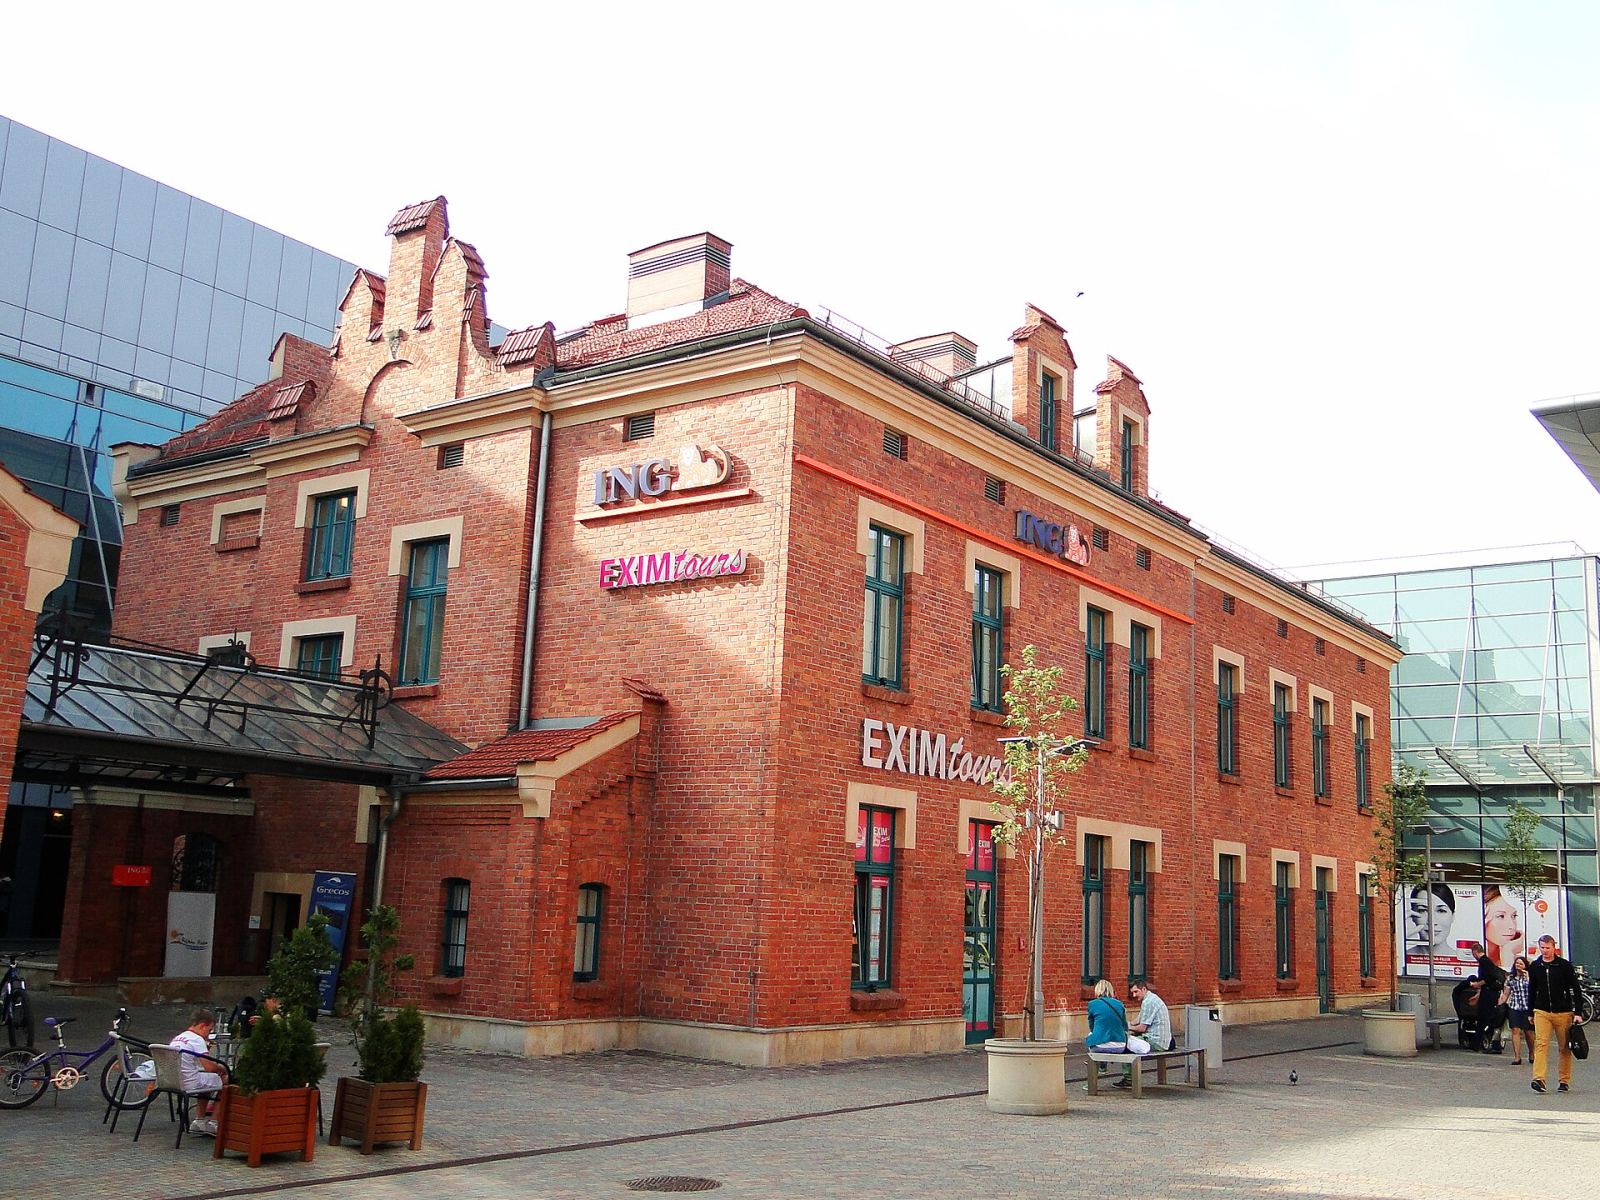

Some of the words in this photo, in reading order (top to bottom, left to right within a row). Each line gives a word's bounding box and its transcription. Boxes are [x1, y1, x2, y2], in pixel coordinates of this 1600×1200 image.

[594, 458, 675, 505] ING
[1013, 509, 1064, 555] ING
[1454, 888, 1478, 896] Eucerin
